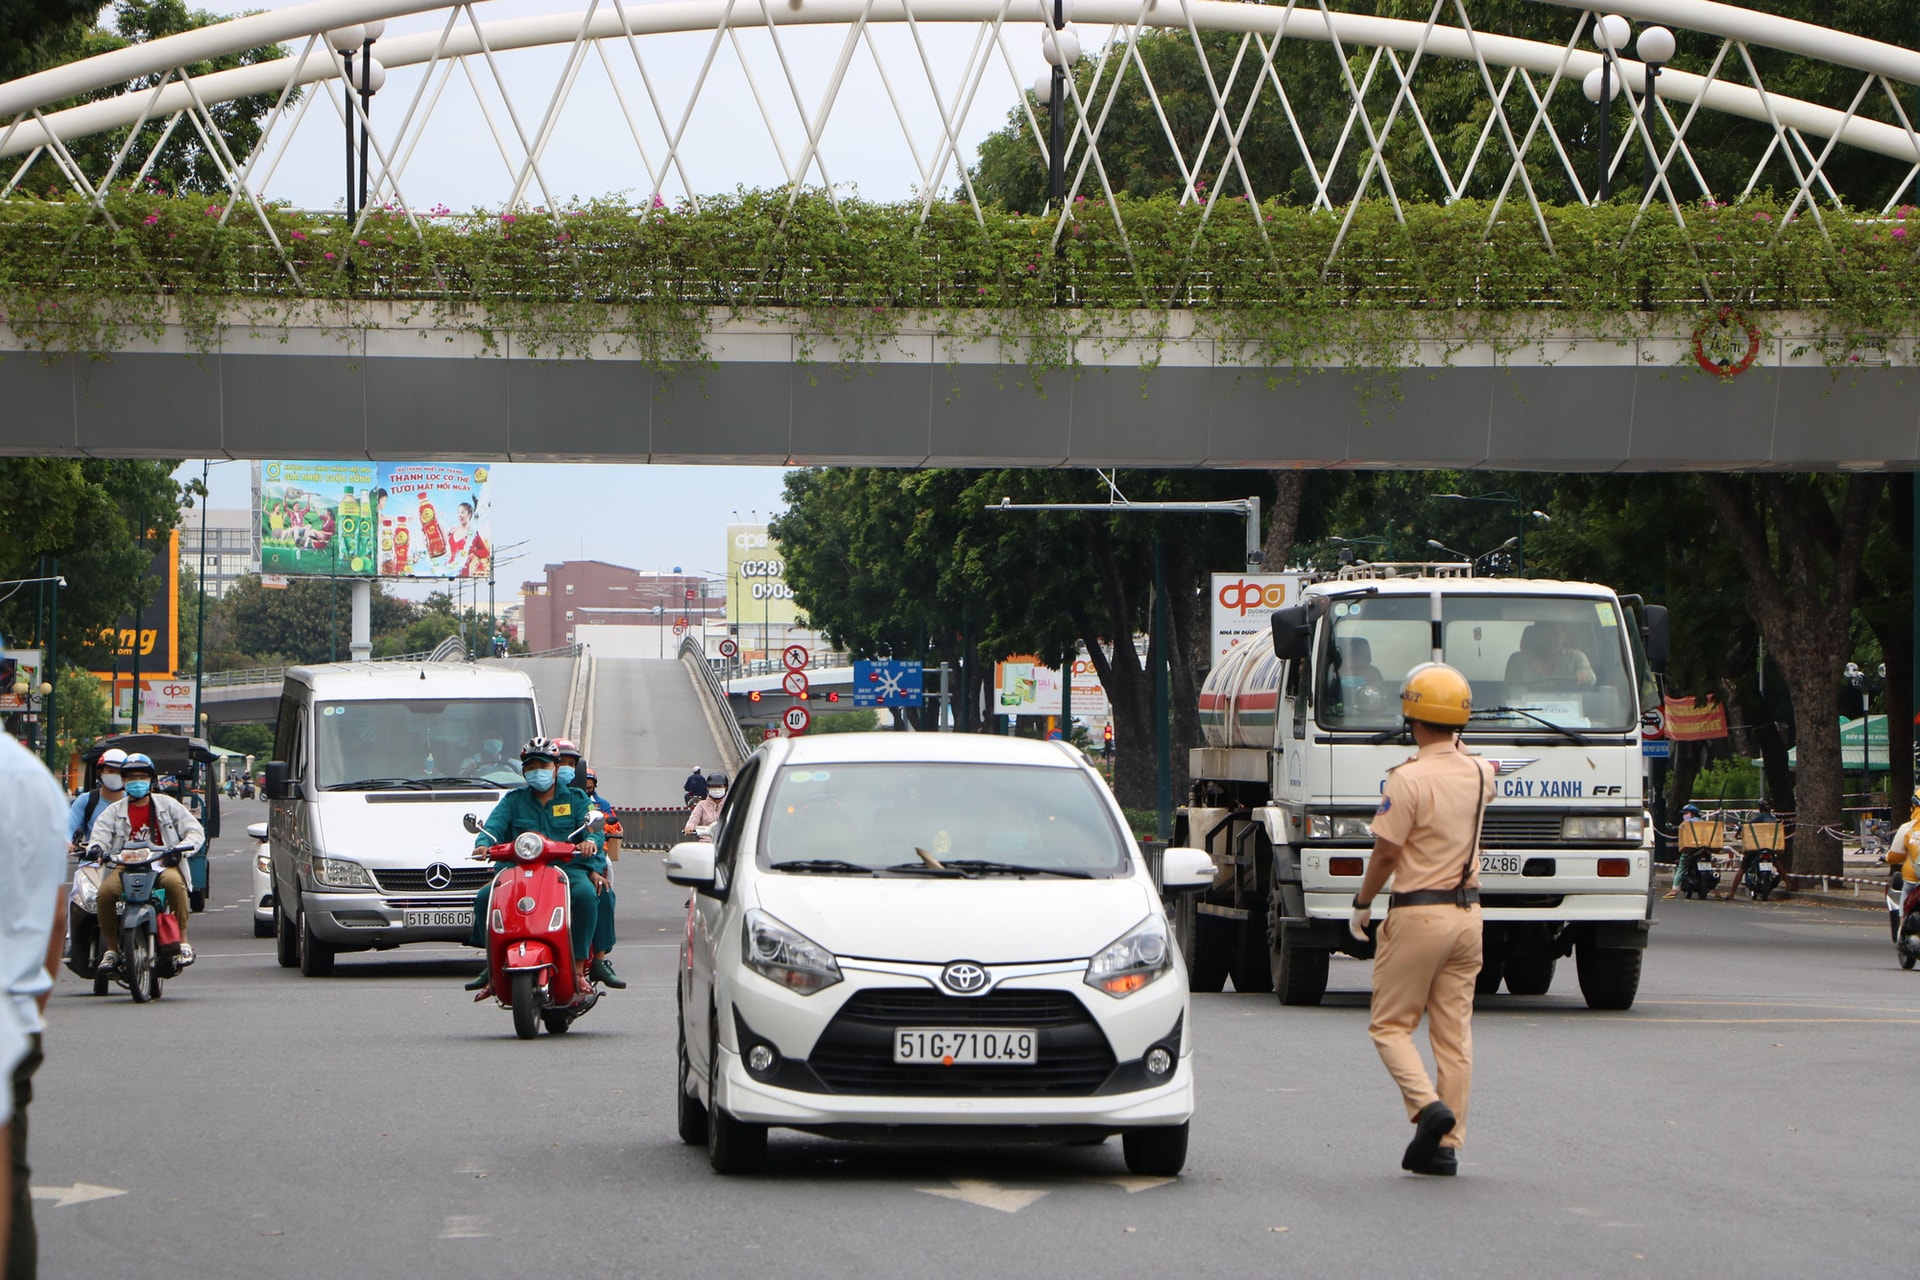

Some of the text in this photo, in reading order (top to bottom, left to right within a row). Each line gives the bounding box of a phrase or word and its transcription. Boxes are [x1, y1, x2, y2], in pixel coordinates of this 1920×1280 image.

[389, 474, 424, 483] THANH
[390, 484, 415, 495] TƯƠI
[723, 644, 733, 652] 30
[1504, 777, 1534, 797] CÂY
[1540, 780, 1582, 797] XANH
[1592, 786, 1622, 796] FF
[900, 1033, 1032, 1060] 51G-710.49
